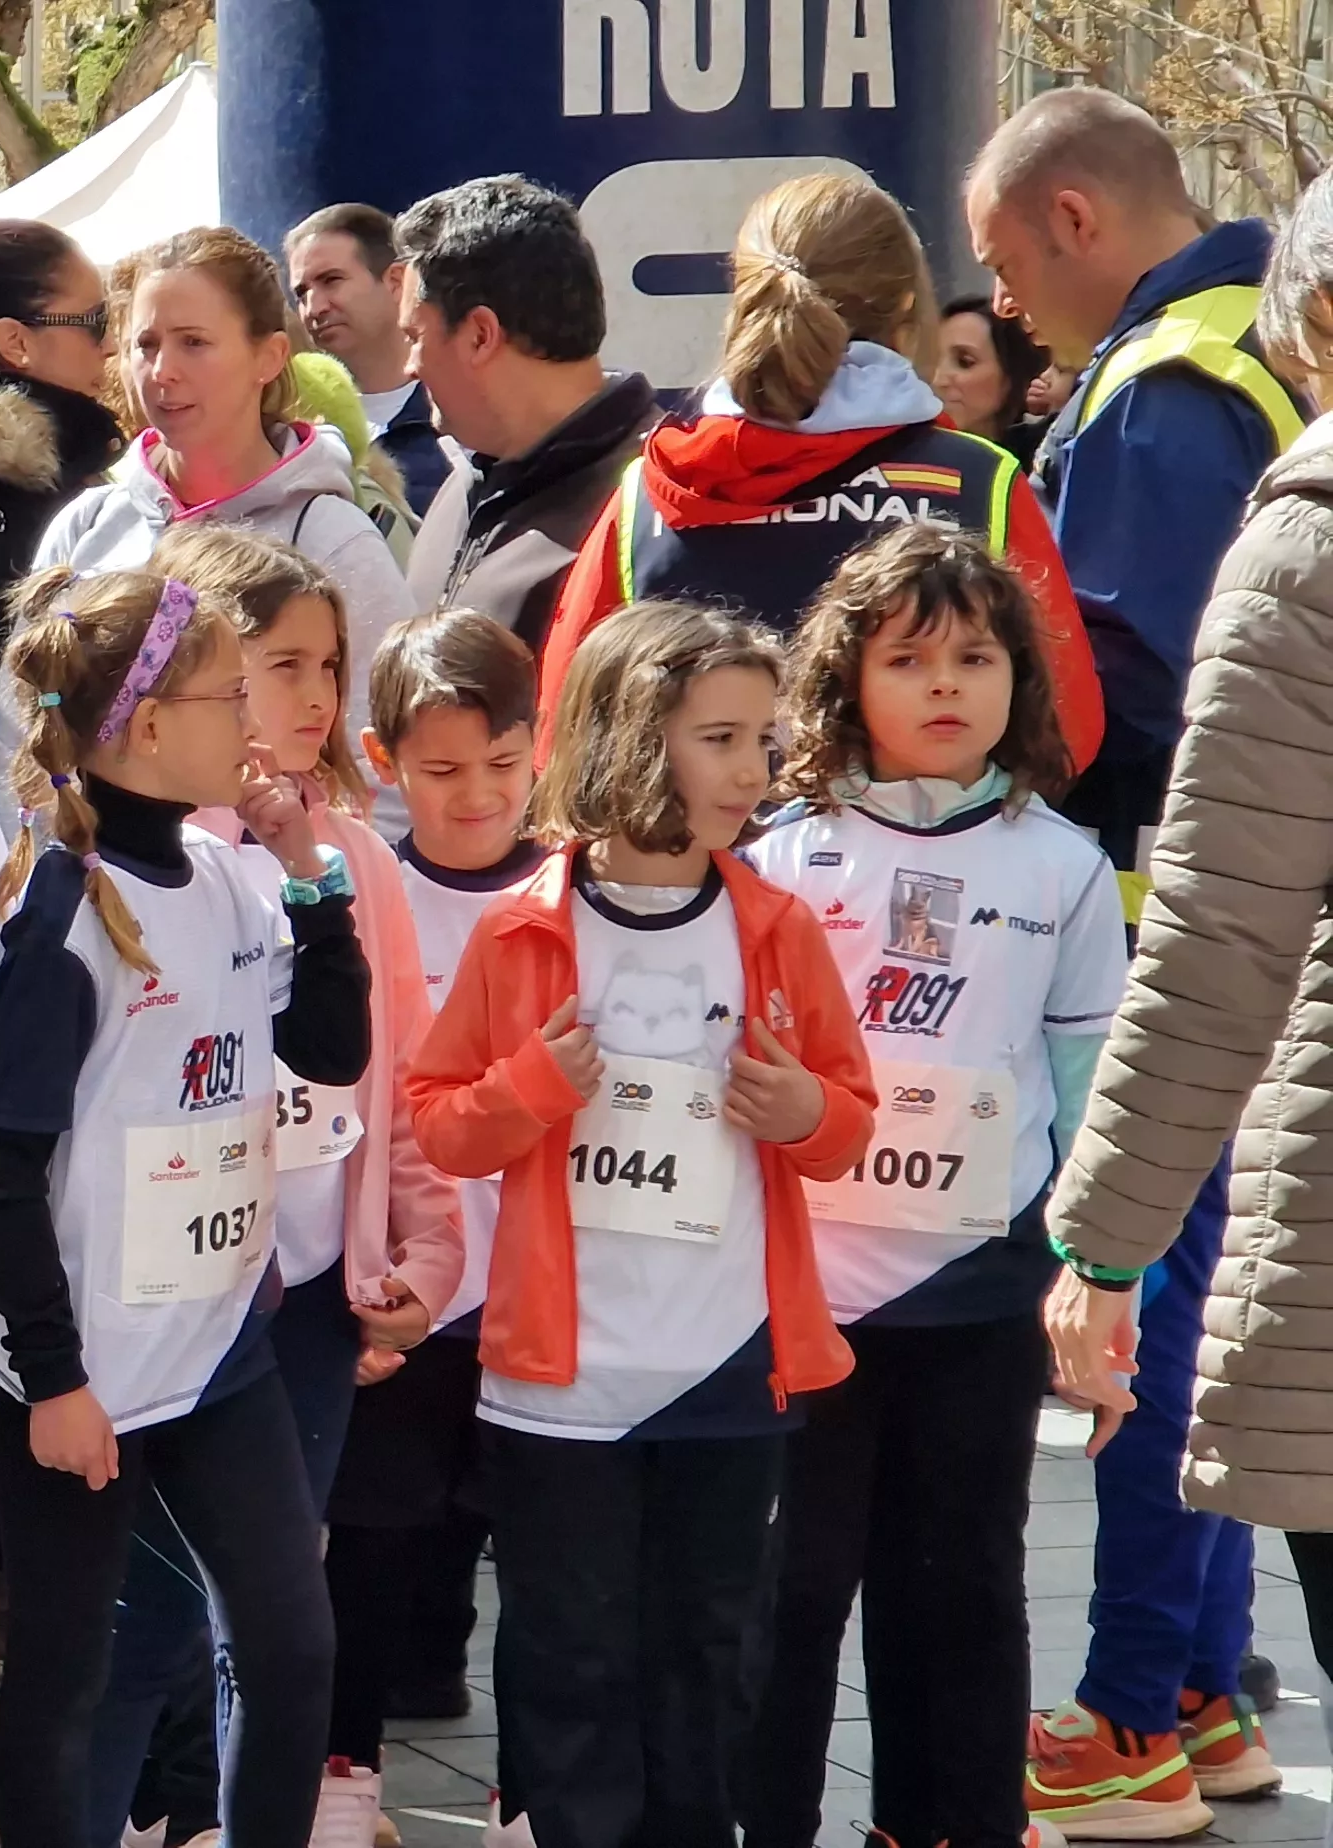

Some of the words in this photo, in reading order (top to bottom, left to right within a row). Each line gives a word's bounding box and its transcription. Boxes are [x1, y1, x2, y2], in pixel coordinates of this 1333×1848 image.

[1008, 916, 1056, 938] mupol
[859, 965, 969, 1030] R091
[148, 1170, 201, 1182] Santander
[568, 1143, 679, 1195] 1044
[185, 1199, 259, 1255] 1037
